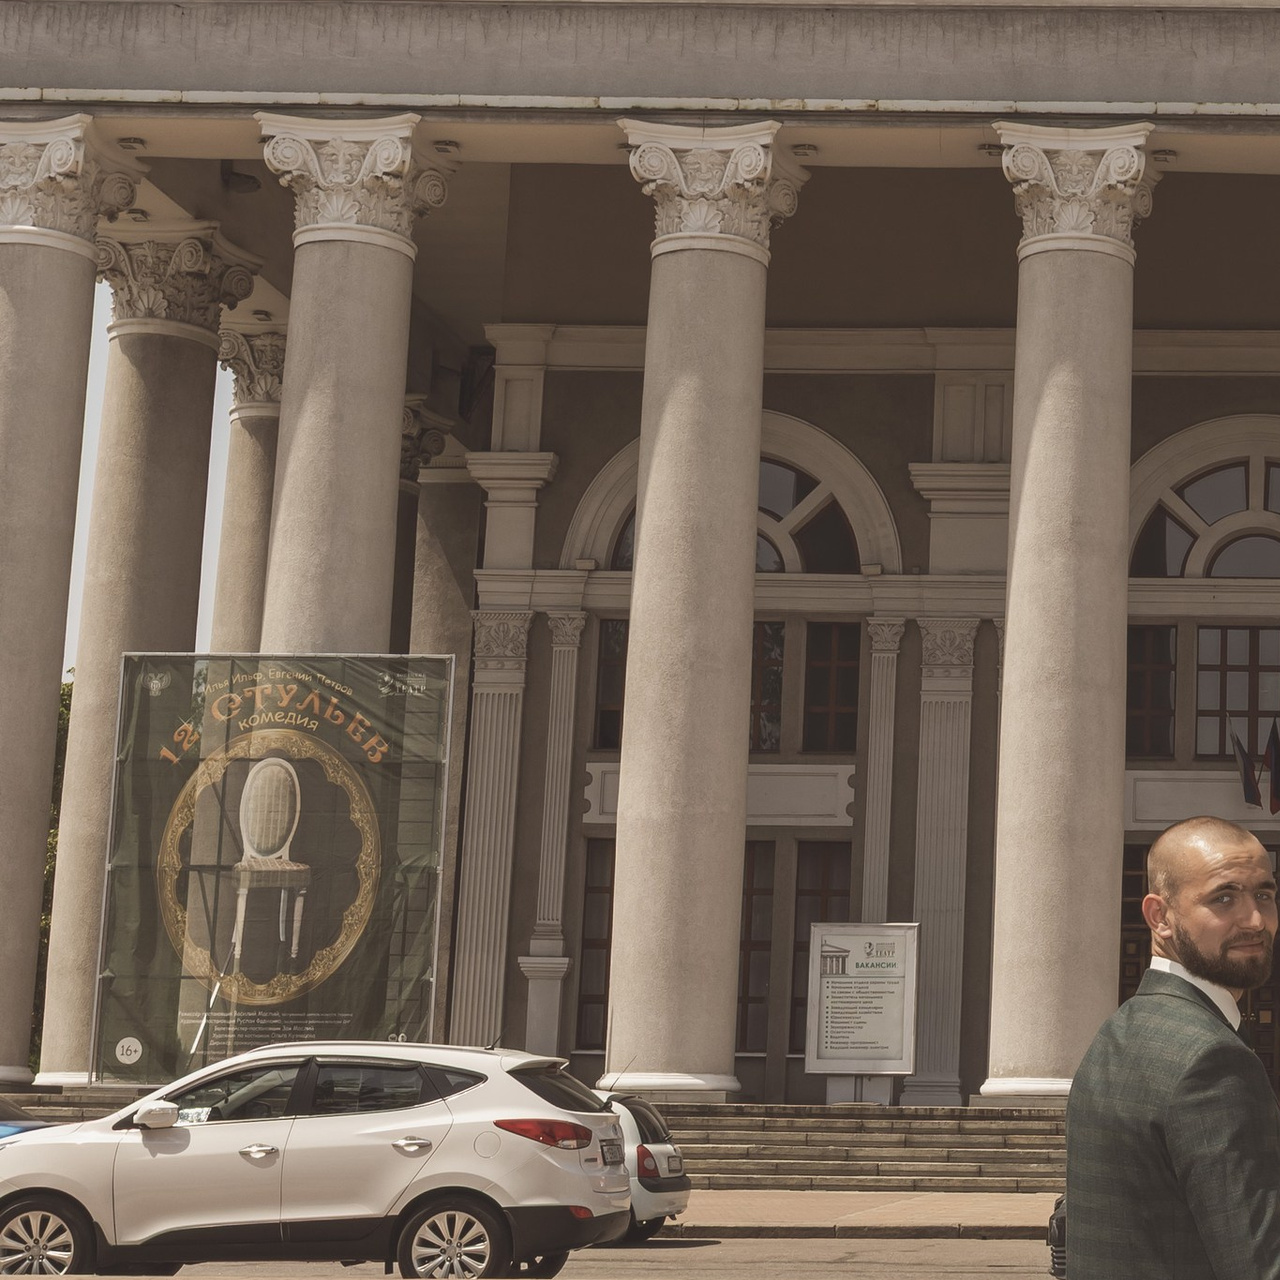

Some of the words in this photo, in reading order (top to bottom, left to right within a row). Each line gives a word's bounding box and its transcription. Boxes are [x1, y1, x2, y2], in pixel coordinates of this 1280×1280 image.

[204, 678, 229, 694] Илья
[232, 672, 266, 685] Ильф,
[269, 668, 312, 682] Евгений
[316, 673, 354, 696] Петров
[159, 722, 200, 764] 12
[211, 684, 391, 763] СТУЛЬЕВ
[238, 712, 319, 732] комедия
[120, 1044, 138, 1057] 16+
